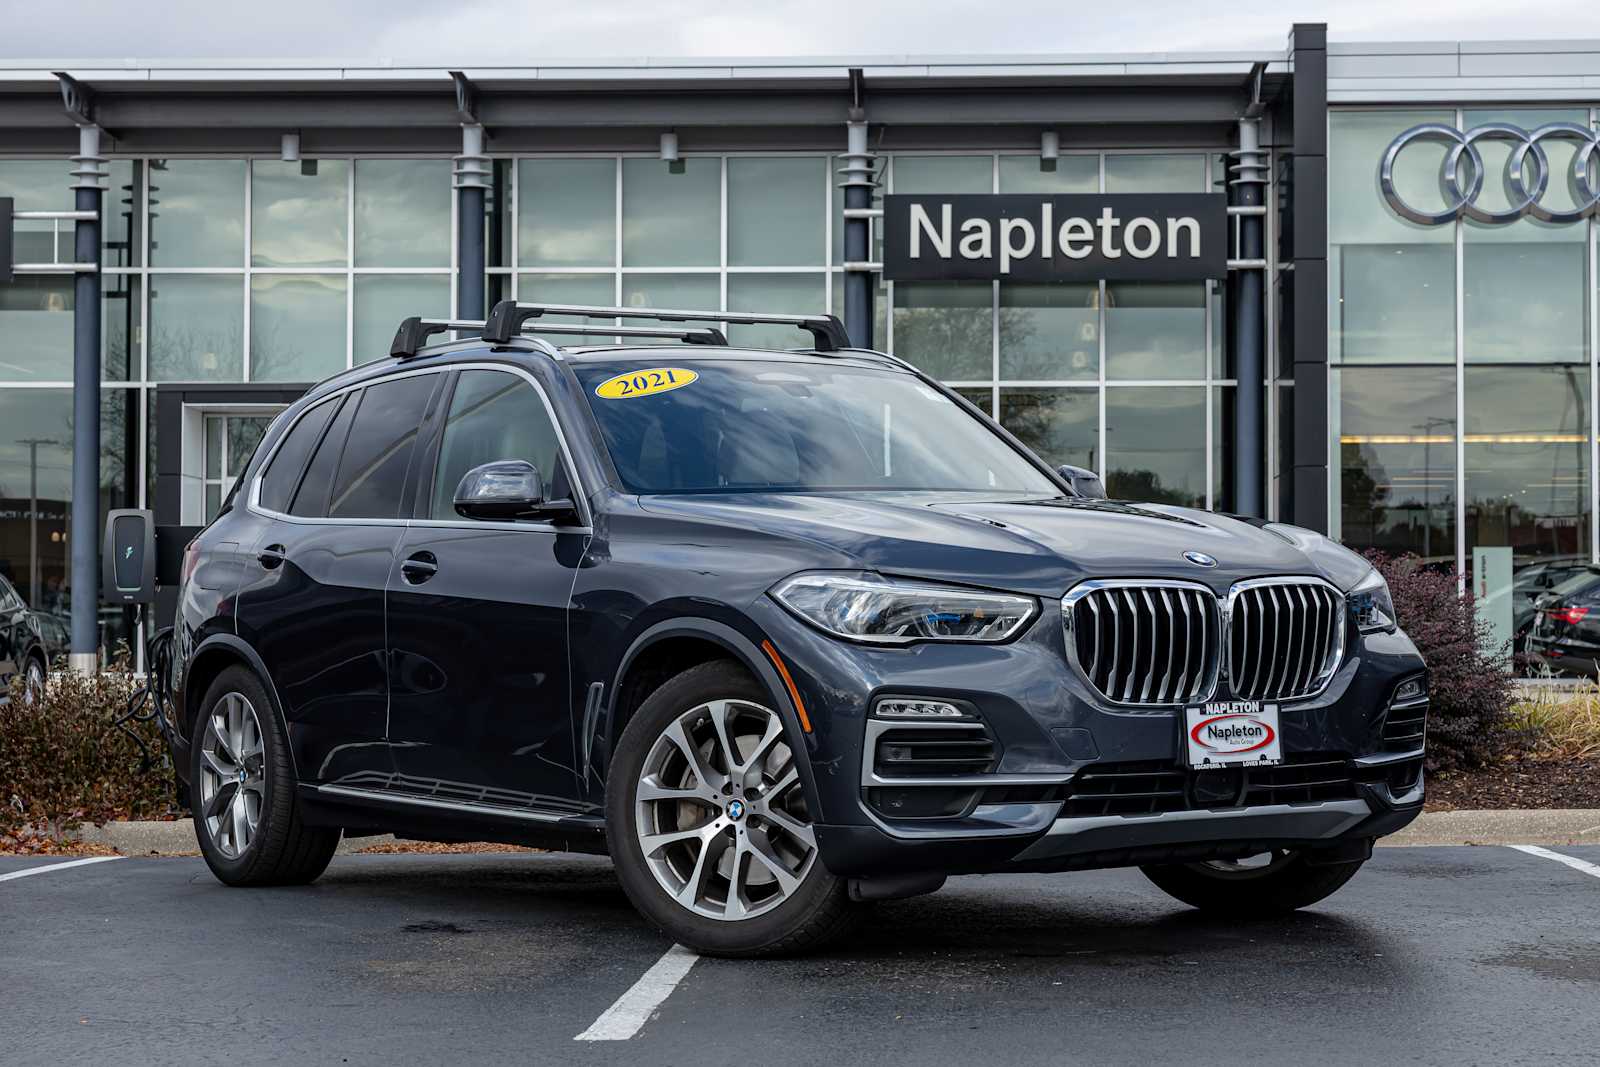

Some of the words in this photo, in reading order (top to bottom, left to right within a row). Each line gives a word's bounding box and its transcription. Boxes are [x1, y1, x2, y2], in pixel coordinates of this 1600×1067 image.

[909, 203, 1201, 273] Napleton
[616, 370, 676, 395] 2021
[1206, 702, 1259, 714] NAPLETON
[1207, 724, 1262, 740] Napleton
